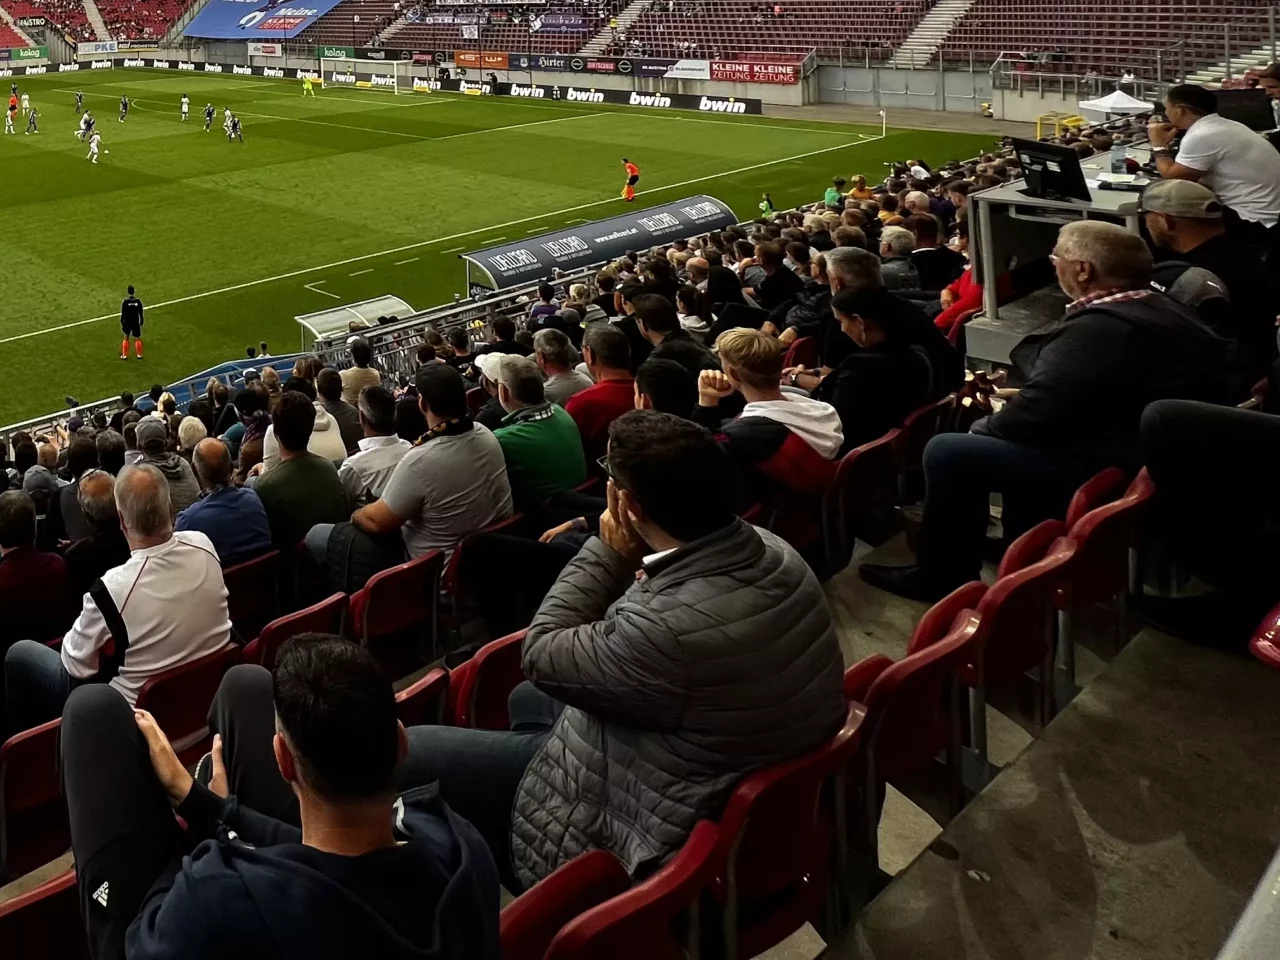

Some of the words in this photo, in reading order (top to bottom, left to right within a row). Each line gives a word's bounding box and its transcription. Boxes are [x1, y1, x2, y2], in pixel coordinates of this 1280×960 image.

[274, 8, 318, 16] Meine
[94, 42, 116, 52] PKE
[20, 48, 40, 58] kelag
[324, 48, 346, 58] kelag
[59, 62, 79, 72] bwin
[91, 59, 111, 69] bwin
[124, 58, 145, 68] bwin
[153, 59, 169, 69] bwin
[178, 61, 194, 71] bwin
[539, 56, 565, 68] Hirter
[26, 64, 46, 75] bwin
[204, 63, 222, 73] bwin
[232, 65, 252, 75] bwin
[263, 67, 284, 78] bwin
[712, 63, 750, 72] KLEINE
[753, 64, 794, 74] KLEINE
[712, 71, 751, 80] ZEITUNG
[752, 72, 794, 82] ZEITUNG
[510, 84, 544, 98] bwin
[566, 88, 604, 102] bwin
[629, 92, 671, 108] bwin
[699, 97, 746, 114] bwin
